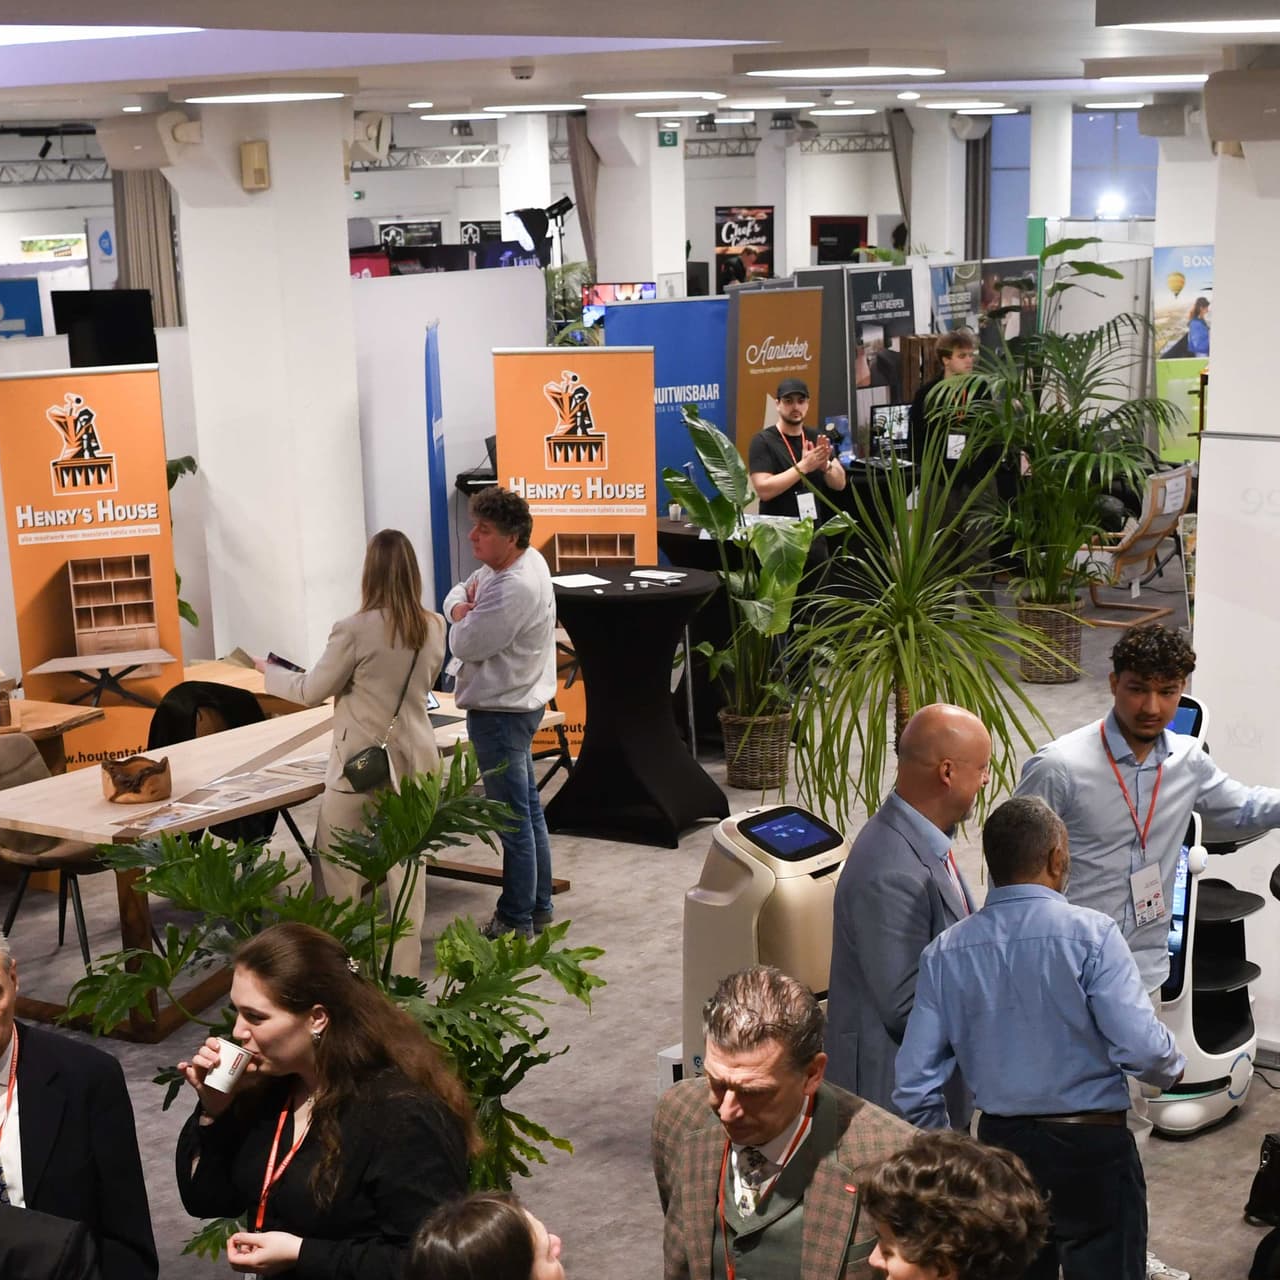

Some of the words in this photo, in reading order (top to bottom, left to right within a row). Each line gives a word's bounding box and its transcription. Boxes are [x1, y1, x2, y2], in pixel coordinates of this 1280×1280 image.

[746, 336, 812, 366] Aansteker
[586, 477, 646, 499] HOUSE
[96, 499, 159, 523] HOUSE
